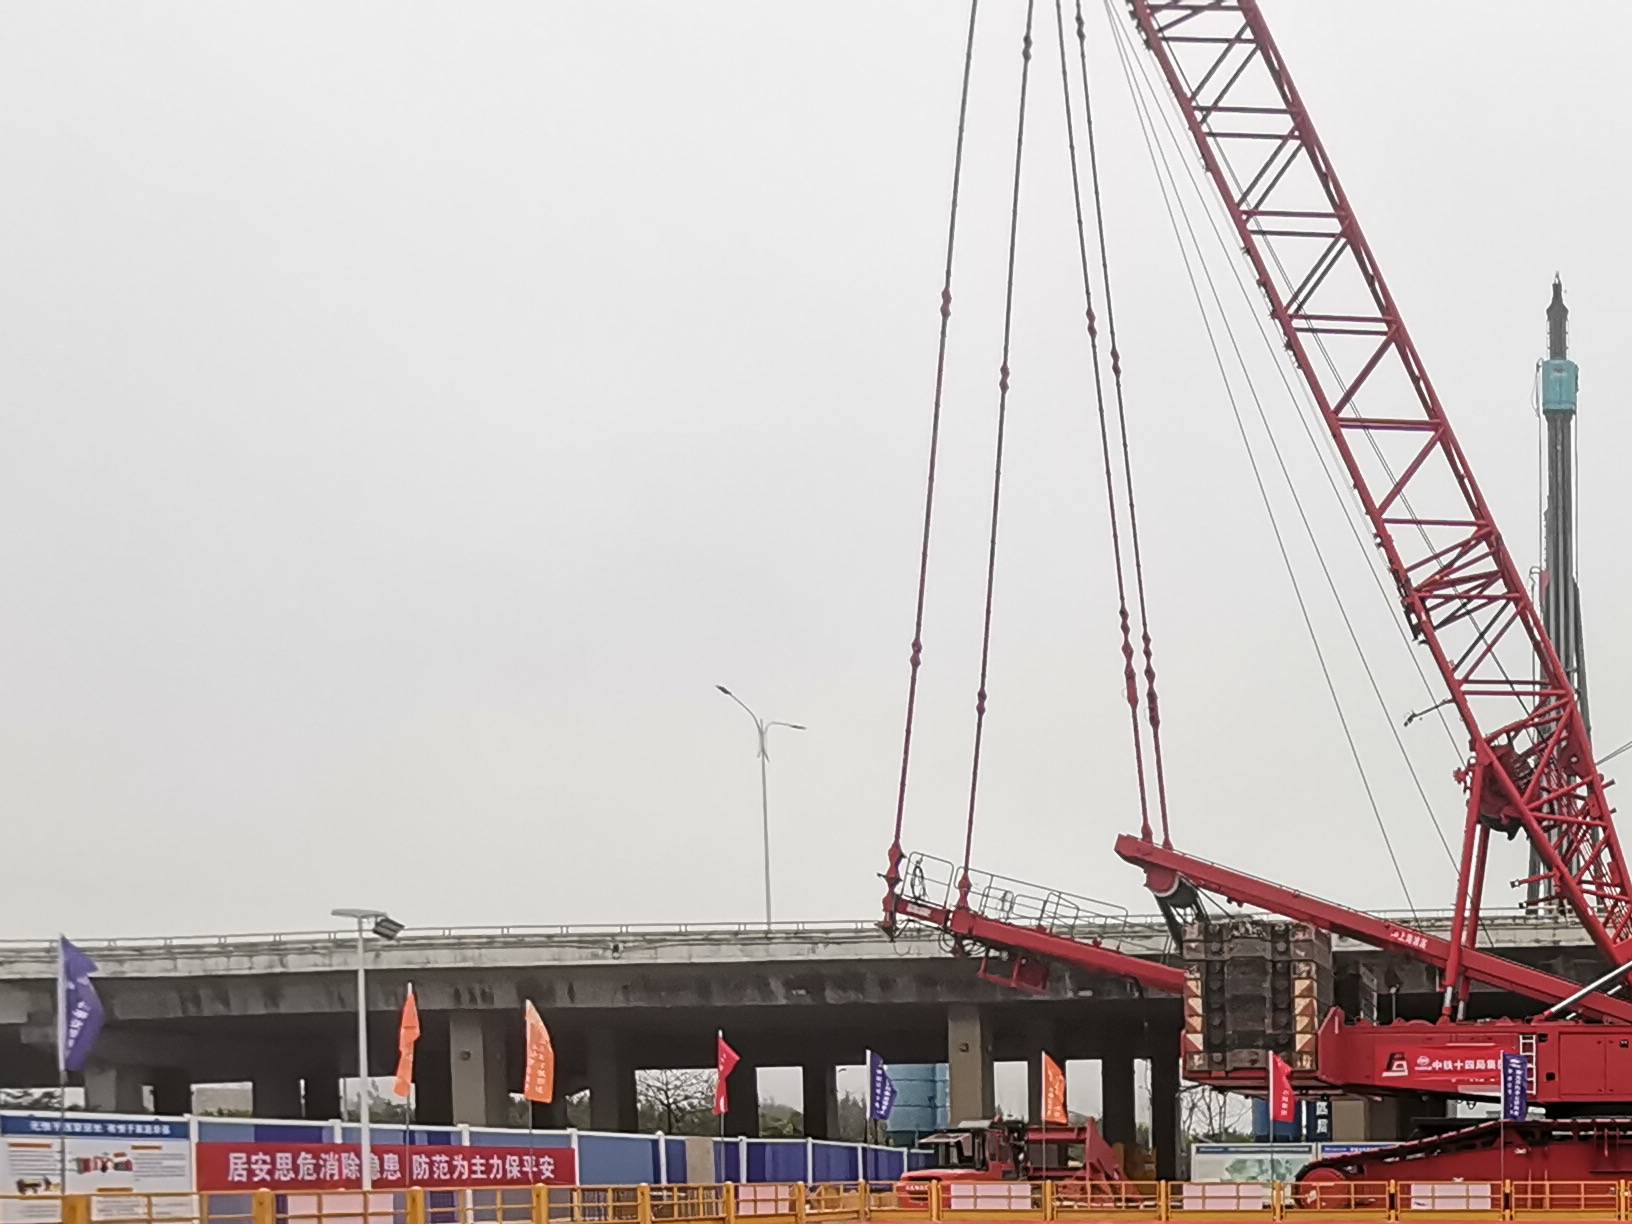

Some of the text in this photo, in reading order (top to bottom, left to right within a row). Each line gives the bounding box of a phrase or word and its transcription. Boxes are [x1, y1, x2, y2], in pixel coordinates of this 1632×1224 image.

[412, 1154, 556, 1181] 防范为主力保平安
